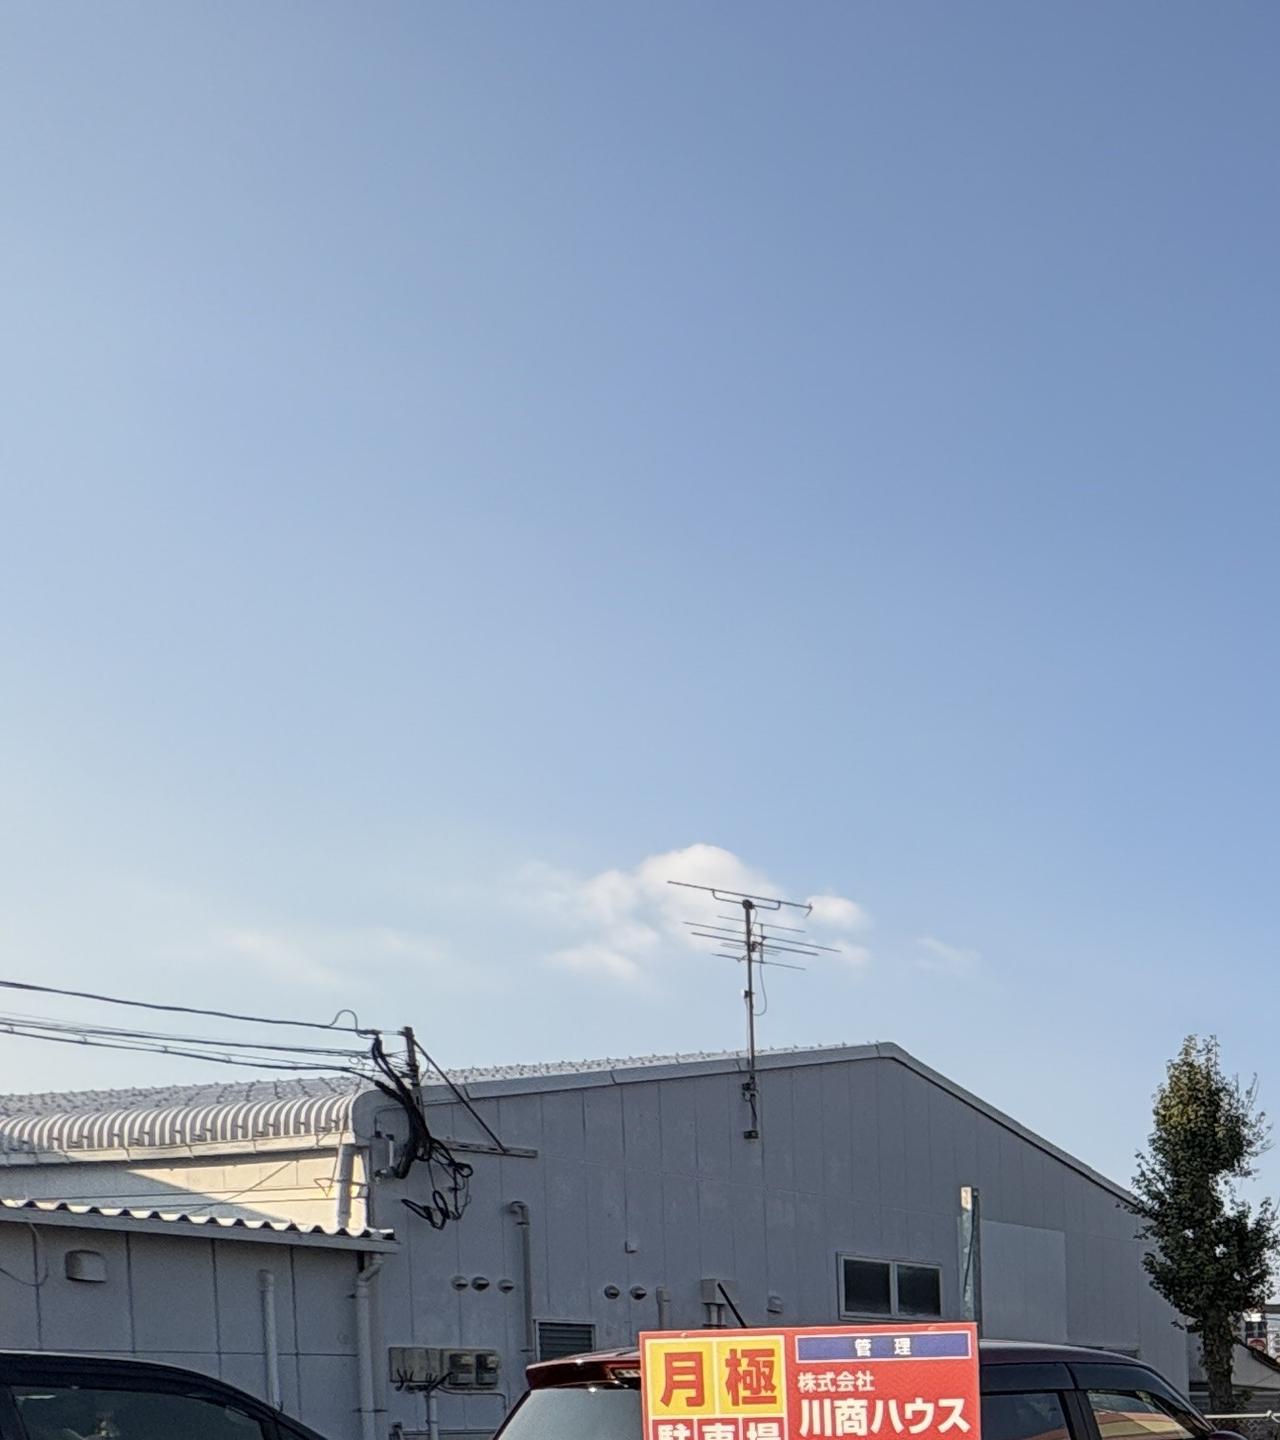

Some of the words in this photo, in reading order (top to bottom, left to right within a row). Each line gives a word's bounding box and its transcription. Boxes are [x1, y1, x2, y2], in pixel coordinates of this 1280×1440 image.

[854, 1336, 913, 1357] 管理
[660, 1348, 778, 1408] 月極
[797, 1370, 876, 1393] 株式会社
[799, 1397, 971, 1438] 川商ハウス
